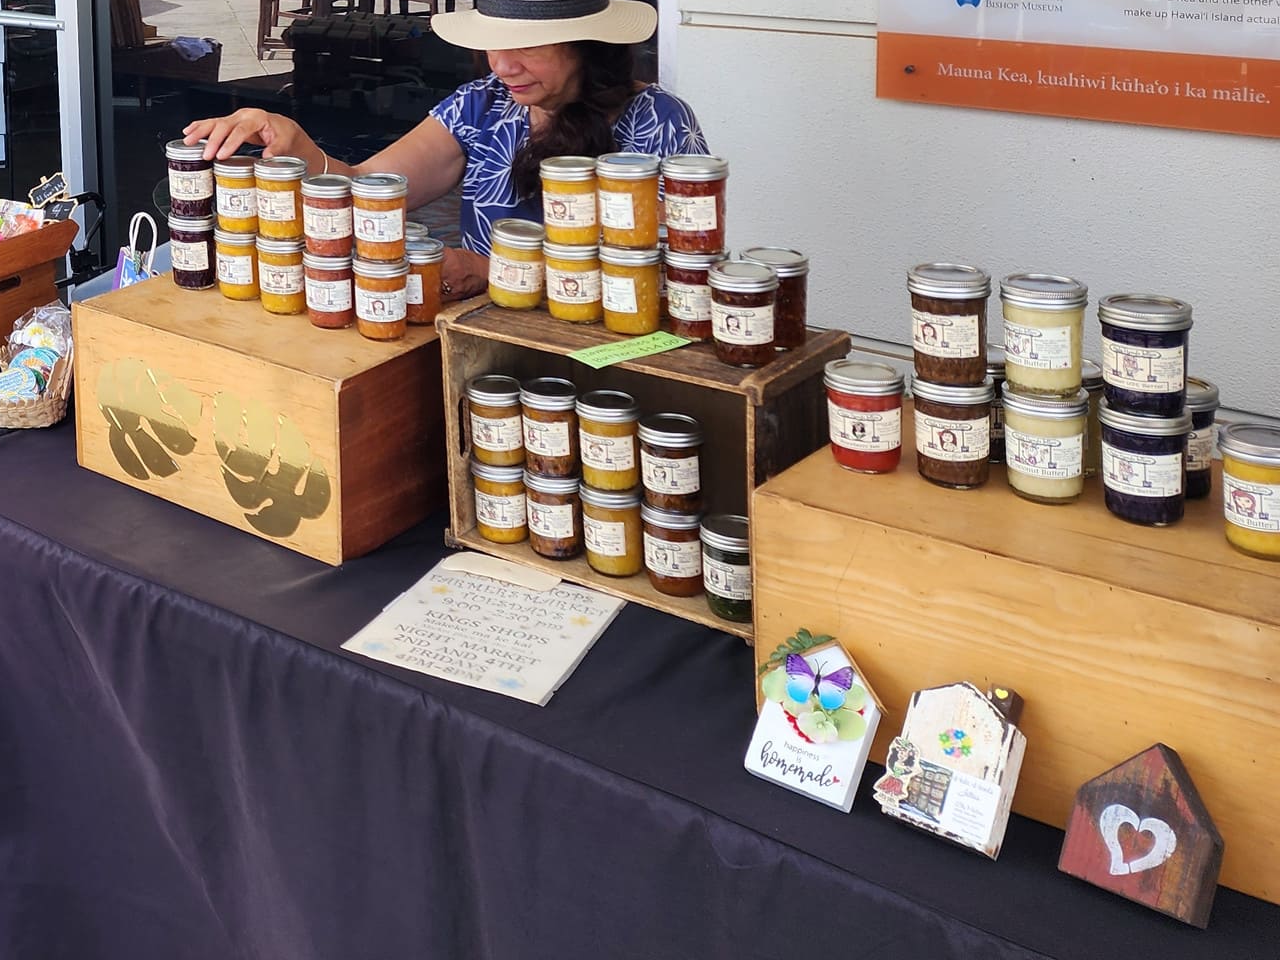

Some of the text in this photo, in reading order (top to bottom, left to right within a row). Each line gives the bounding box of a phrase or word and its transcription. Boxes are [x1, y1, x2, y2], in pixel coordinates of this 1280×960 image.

[1124, 8, 1152, 17] make
[1154, 10, 1168, 20] up
[1211, 12, 1243, 22] Island
[937, 62, 992, 80] Mauna
[998, 67, 1033, 85] Kea,
[1037, 69, 1106, 90] kuahiwi
[1174, 82, 1180, 96] i
[1184, 82, 1207, 99] ka
[1212, 87, 1271, 104] mālie.
[395, 624, 455, 643] NIGHT
[461, 641, 542, 665] MARKET
[426, 610, 481, 628] KINGS
[487, 625, 549, 645] SHOPS
[394, 633, 523, 672] 2ND AND 4TH
[409, 647, 488, 673] FRIDAYS
[761, 740, 834, 787] homemade
[784, 741, 820, 762] happiness
